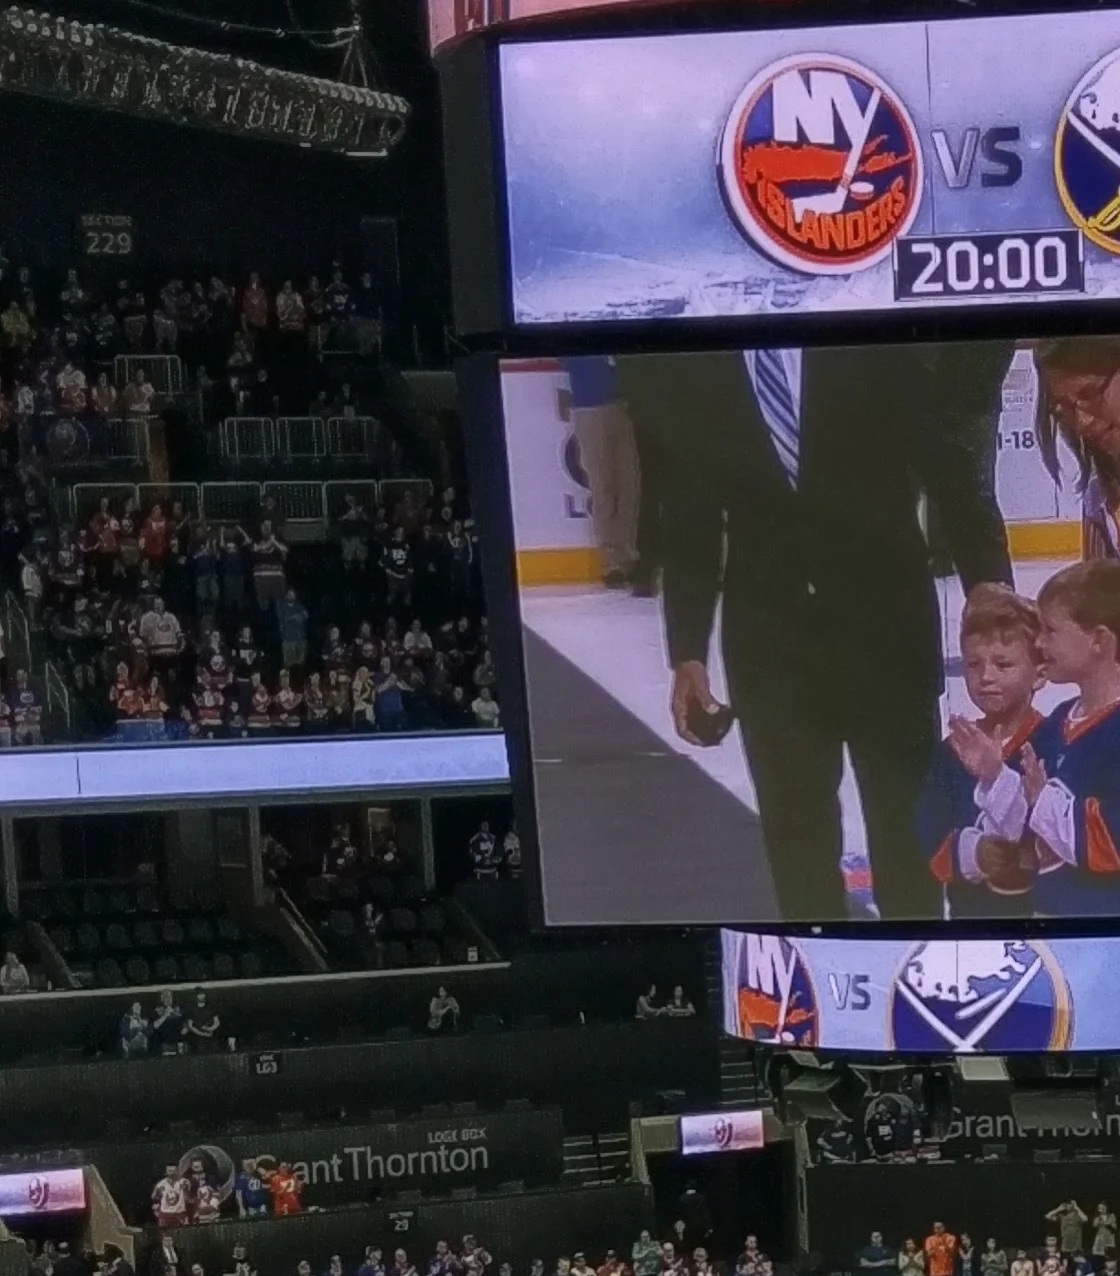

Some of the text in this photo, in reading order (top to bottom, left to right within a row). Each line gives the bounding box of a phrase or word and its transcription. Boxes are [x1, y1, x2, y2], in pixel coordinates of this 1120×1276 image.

[932, 127, 1023, 188] VS
[757, 174, 906, 252] ISLANDERS
[87, 231, 132, 254] 229
[911, 236, 1067, 294] 20:00
[828, 972, 870, 1011] VS
[343, 1145, 489, 1183] Thornton
